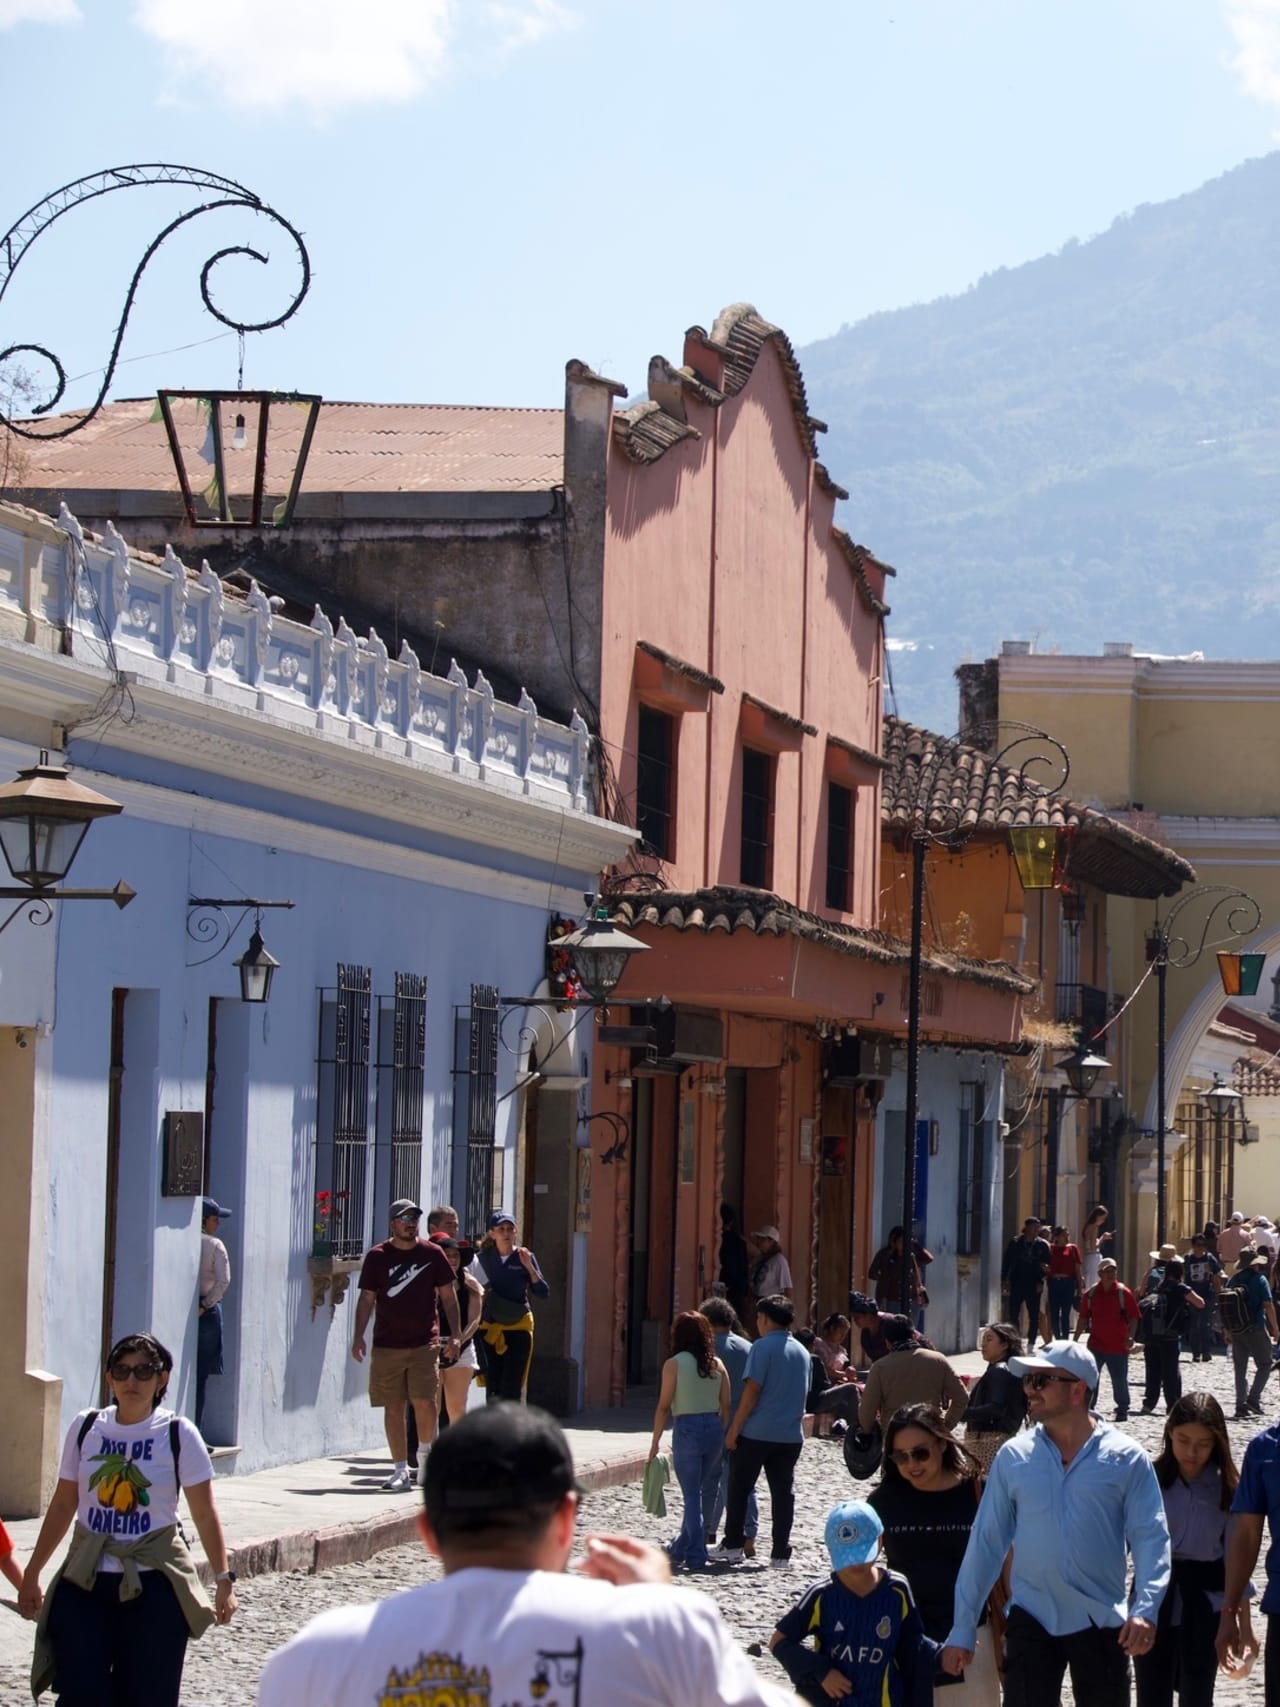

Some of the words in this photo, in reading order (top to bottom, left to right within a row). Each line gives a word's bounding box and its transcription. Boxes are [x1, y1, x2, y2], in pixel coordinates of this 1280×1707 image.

[132, 1438, 154, 1460] DE
[88, 1507, 151, 1535] JANEIRO
[889, 1526, 925, 1534] TOMMY
[935, 1524, 971, 1533] HILFIG
[831, 1644, 883, 1664] KAFD
